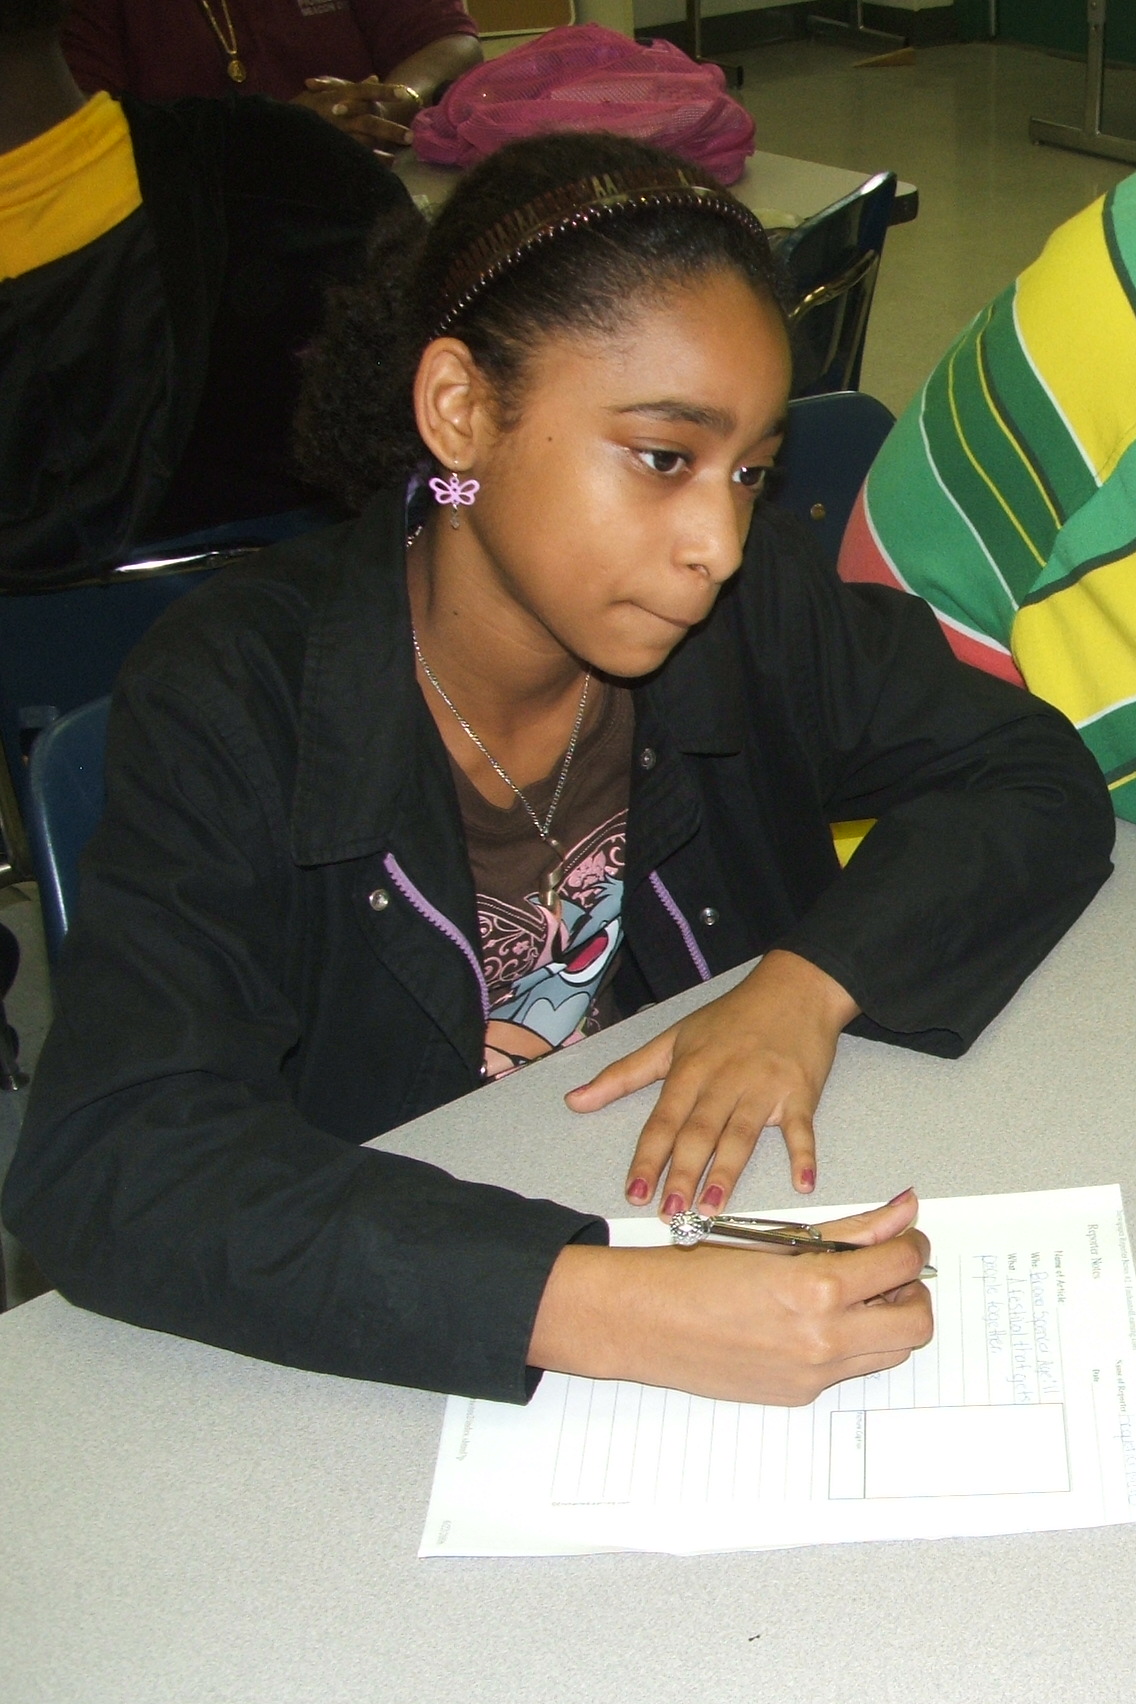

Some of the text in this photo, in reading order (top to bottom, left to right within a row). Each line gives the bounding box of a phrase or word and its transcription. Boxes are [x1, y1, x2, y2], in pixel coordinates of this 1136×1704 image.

[1054, 1250, 1064, 1269] Name
[1086, 1224, 1103, 1280] Reporter Notes
